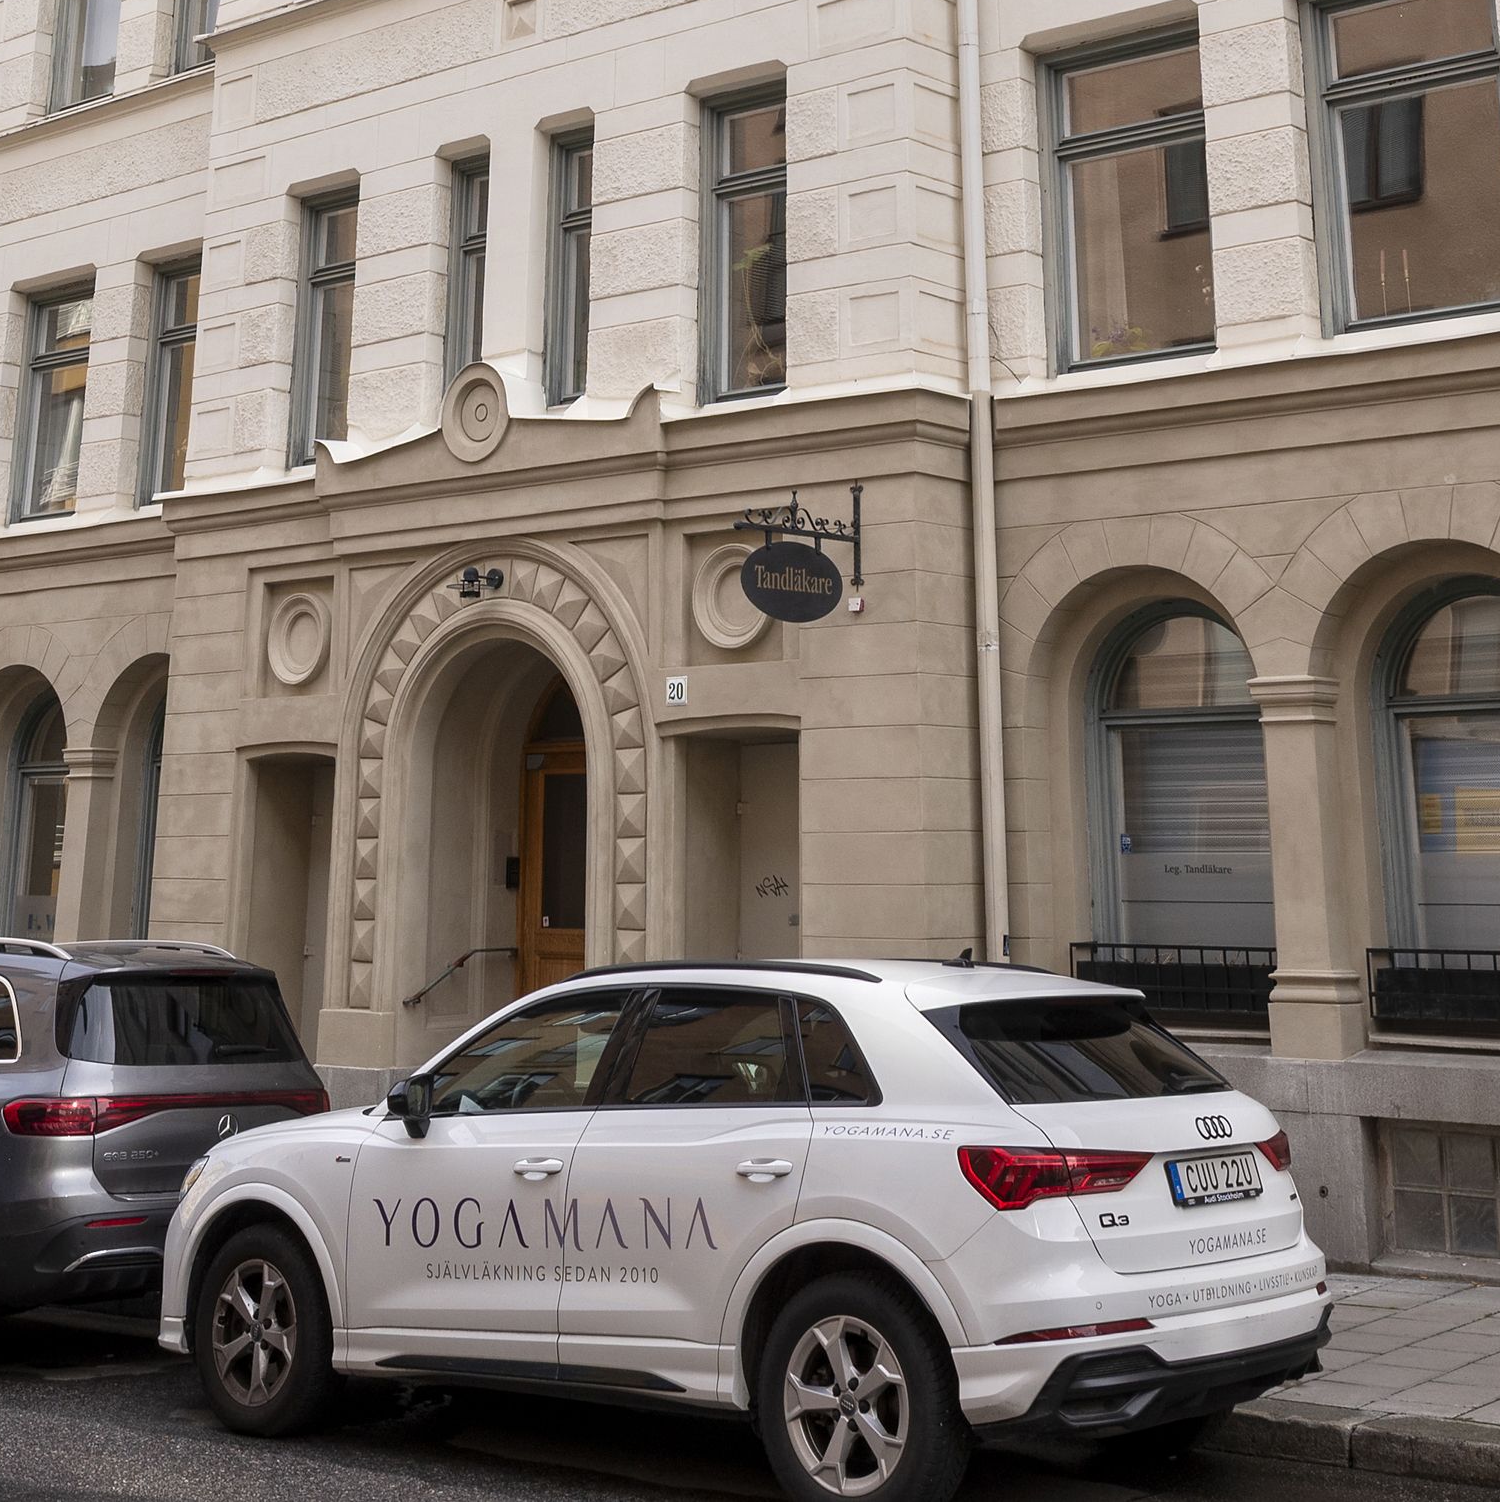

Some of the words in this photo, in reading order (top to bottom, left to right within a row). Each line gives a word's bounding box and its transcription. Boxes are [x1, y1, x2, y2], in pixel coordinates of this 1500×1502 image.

[754, 564, 833, 595] Tandläkare
[668, 682, 684, 700] 20
[1184, 864, 1233, 875] Tandläkare
[823, 1125, 956, 1140] YOGAMANA.SE
[1185, 1161, 1219, 1194] CUU
[1216, 1191, 1245, 1202] Stockholm
[372, 1196, 719, 1252] YOGAMANA
[1099, 1212, 1130, 1228] Q3
[1188, 1227, 1267, 1256] YOGAMANA.SE
[425, 1260, 547, 1283] SJÄLVLÄKNING
[554, 1264, 612, 1283] SEDAN
[619, 1266, 660, 1284] 2010
[1148, 1291, 1182, 1309] YOGA
[1192, 1280, 1252, 1303] UTBILDNING
